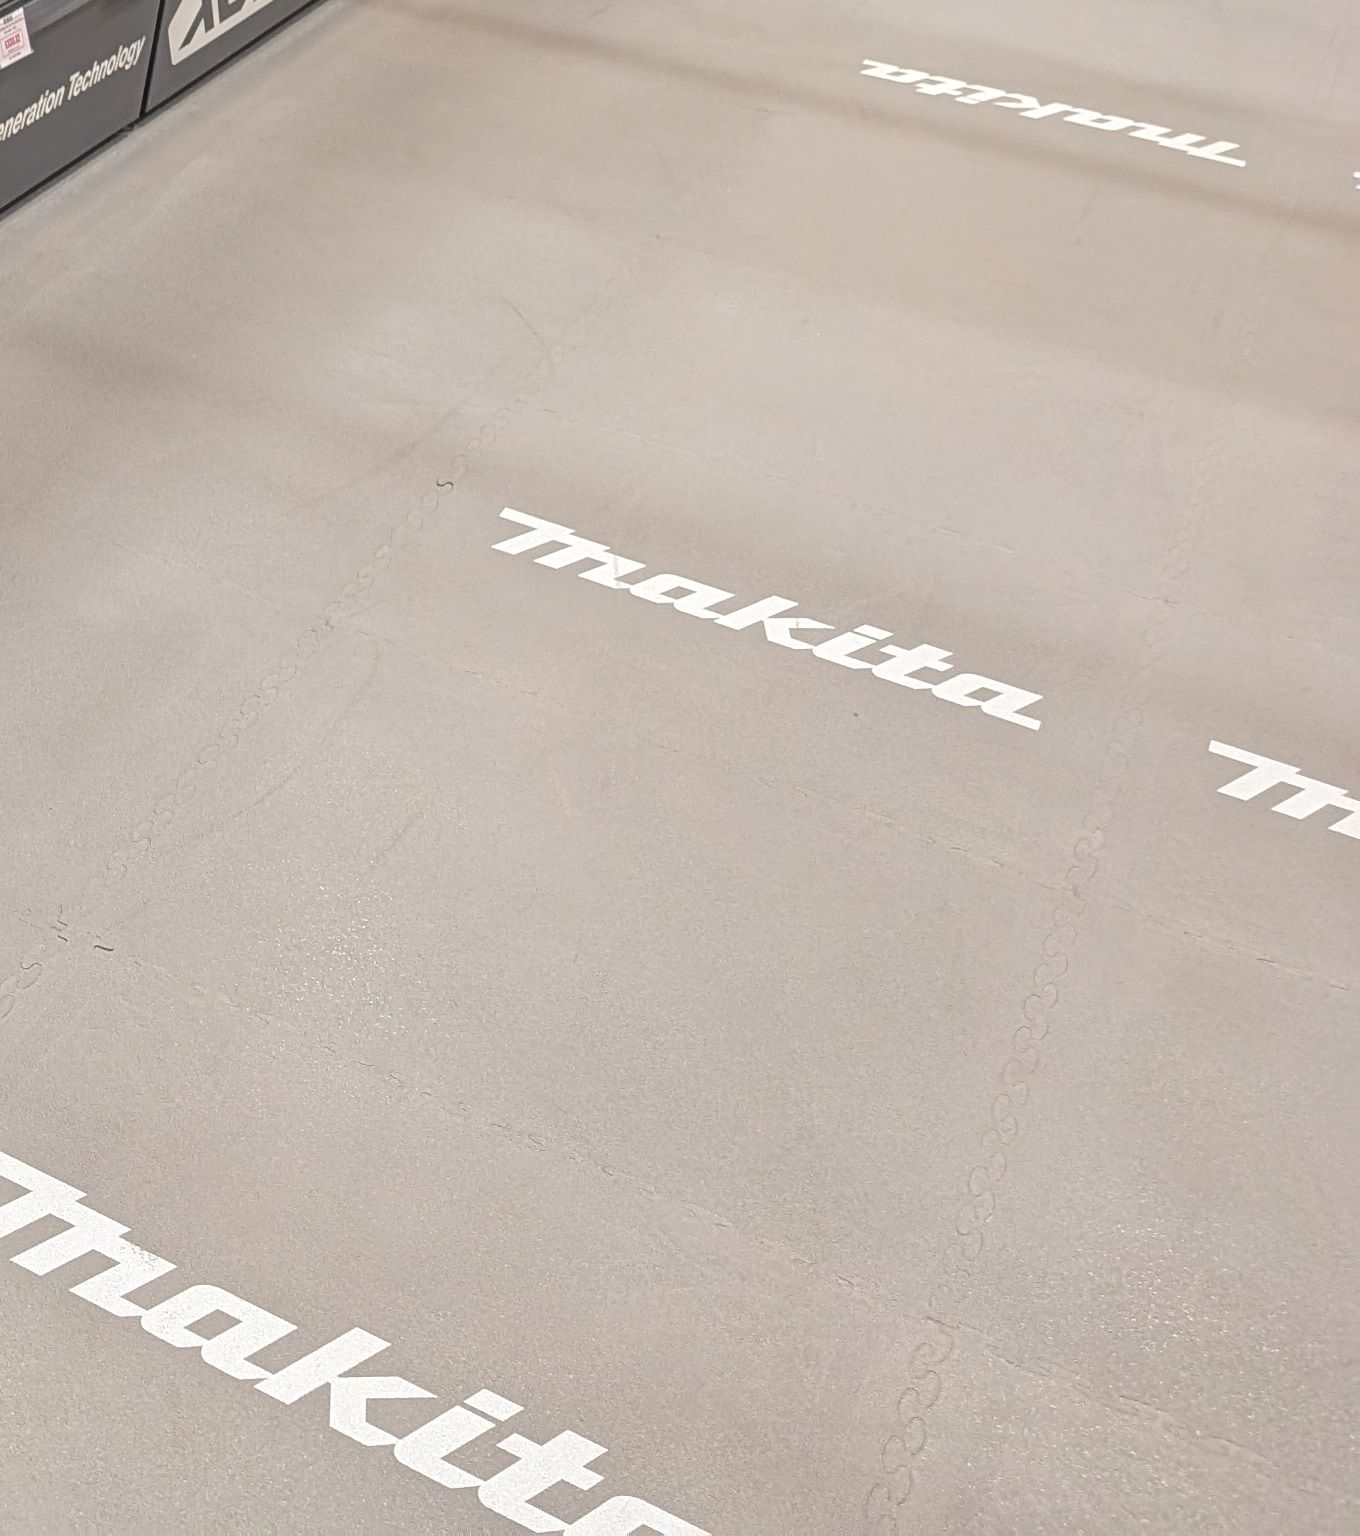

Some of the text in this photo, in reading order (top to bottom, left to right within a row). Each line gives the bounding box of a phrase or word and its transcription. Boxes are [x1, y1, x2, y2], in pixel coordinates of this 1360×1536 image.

[69, 35, 147, 100] Technology
[860, 58, 1247, 168] Makita
[491, 506, 1044, 731] Makita
